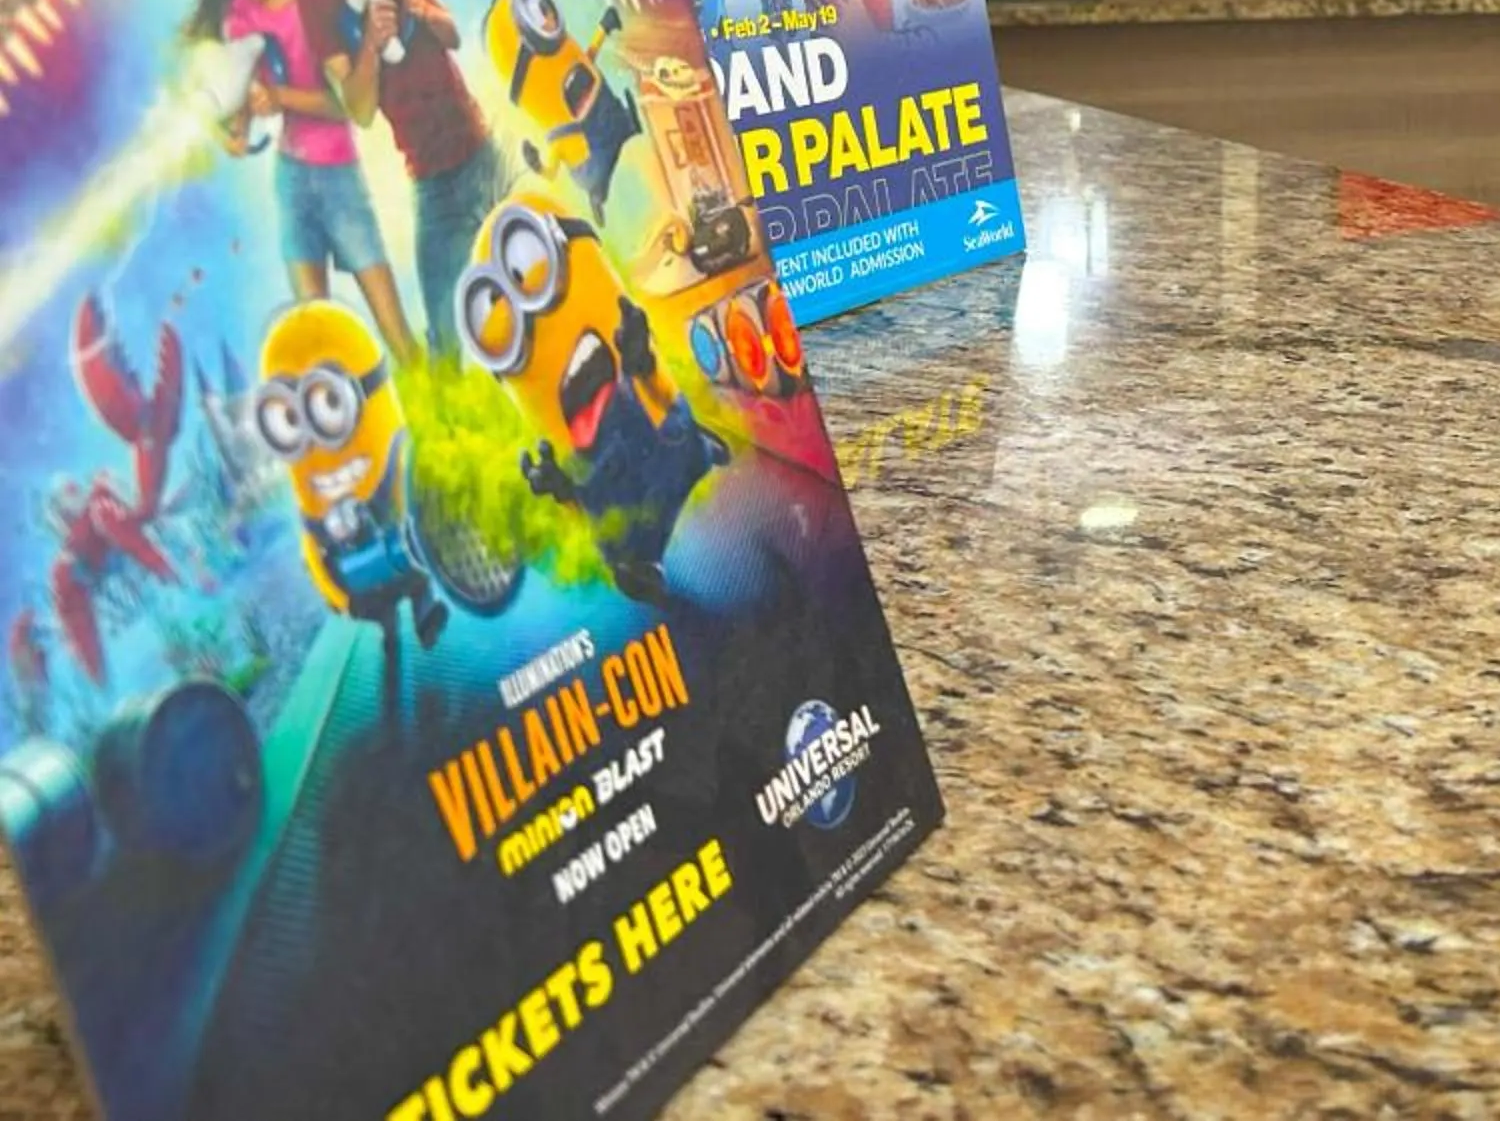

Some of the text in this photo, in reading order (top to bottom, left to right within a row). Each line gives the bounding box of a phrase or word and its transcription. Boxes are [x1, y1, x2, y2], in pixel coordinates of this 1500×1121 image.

[722, 16, 757, 40] Feb
[781, 9, 818, 31] May
[819, 4, 838, 25] 19
[709, 37, 848, 120] AND
[735, 83, 988, 198] R PALATE
[811, 232, 881, 268] INCLUDED
[885, 219, 920, 241] WITH
[850, 241, 925, 279] ADMISSION
[963, 221, 1015, 253] SeaWorld
[428, 624, 690, 863] VILLAIN-CON
[592, 727, 665, 804] BLAST
[756, 704, 881, 825] UNIVERSAL
[782, 742, 871, 828] ORLANDO RESORT
[552, 803, 657, 904] NOW OPEN
[613, 839, 733, 975] HERE
